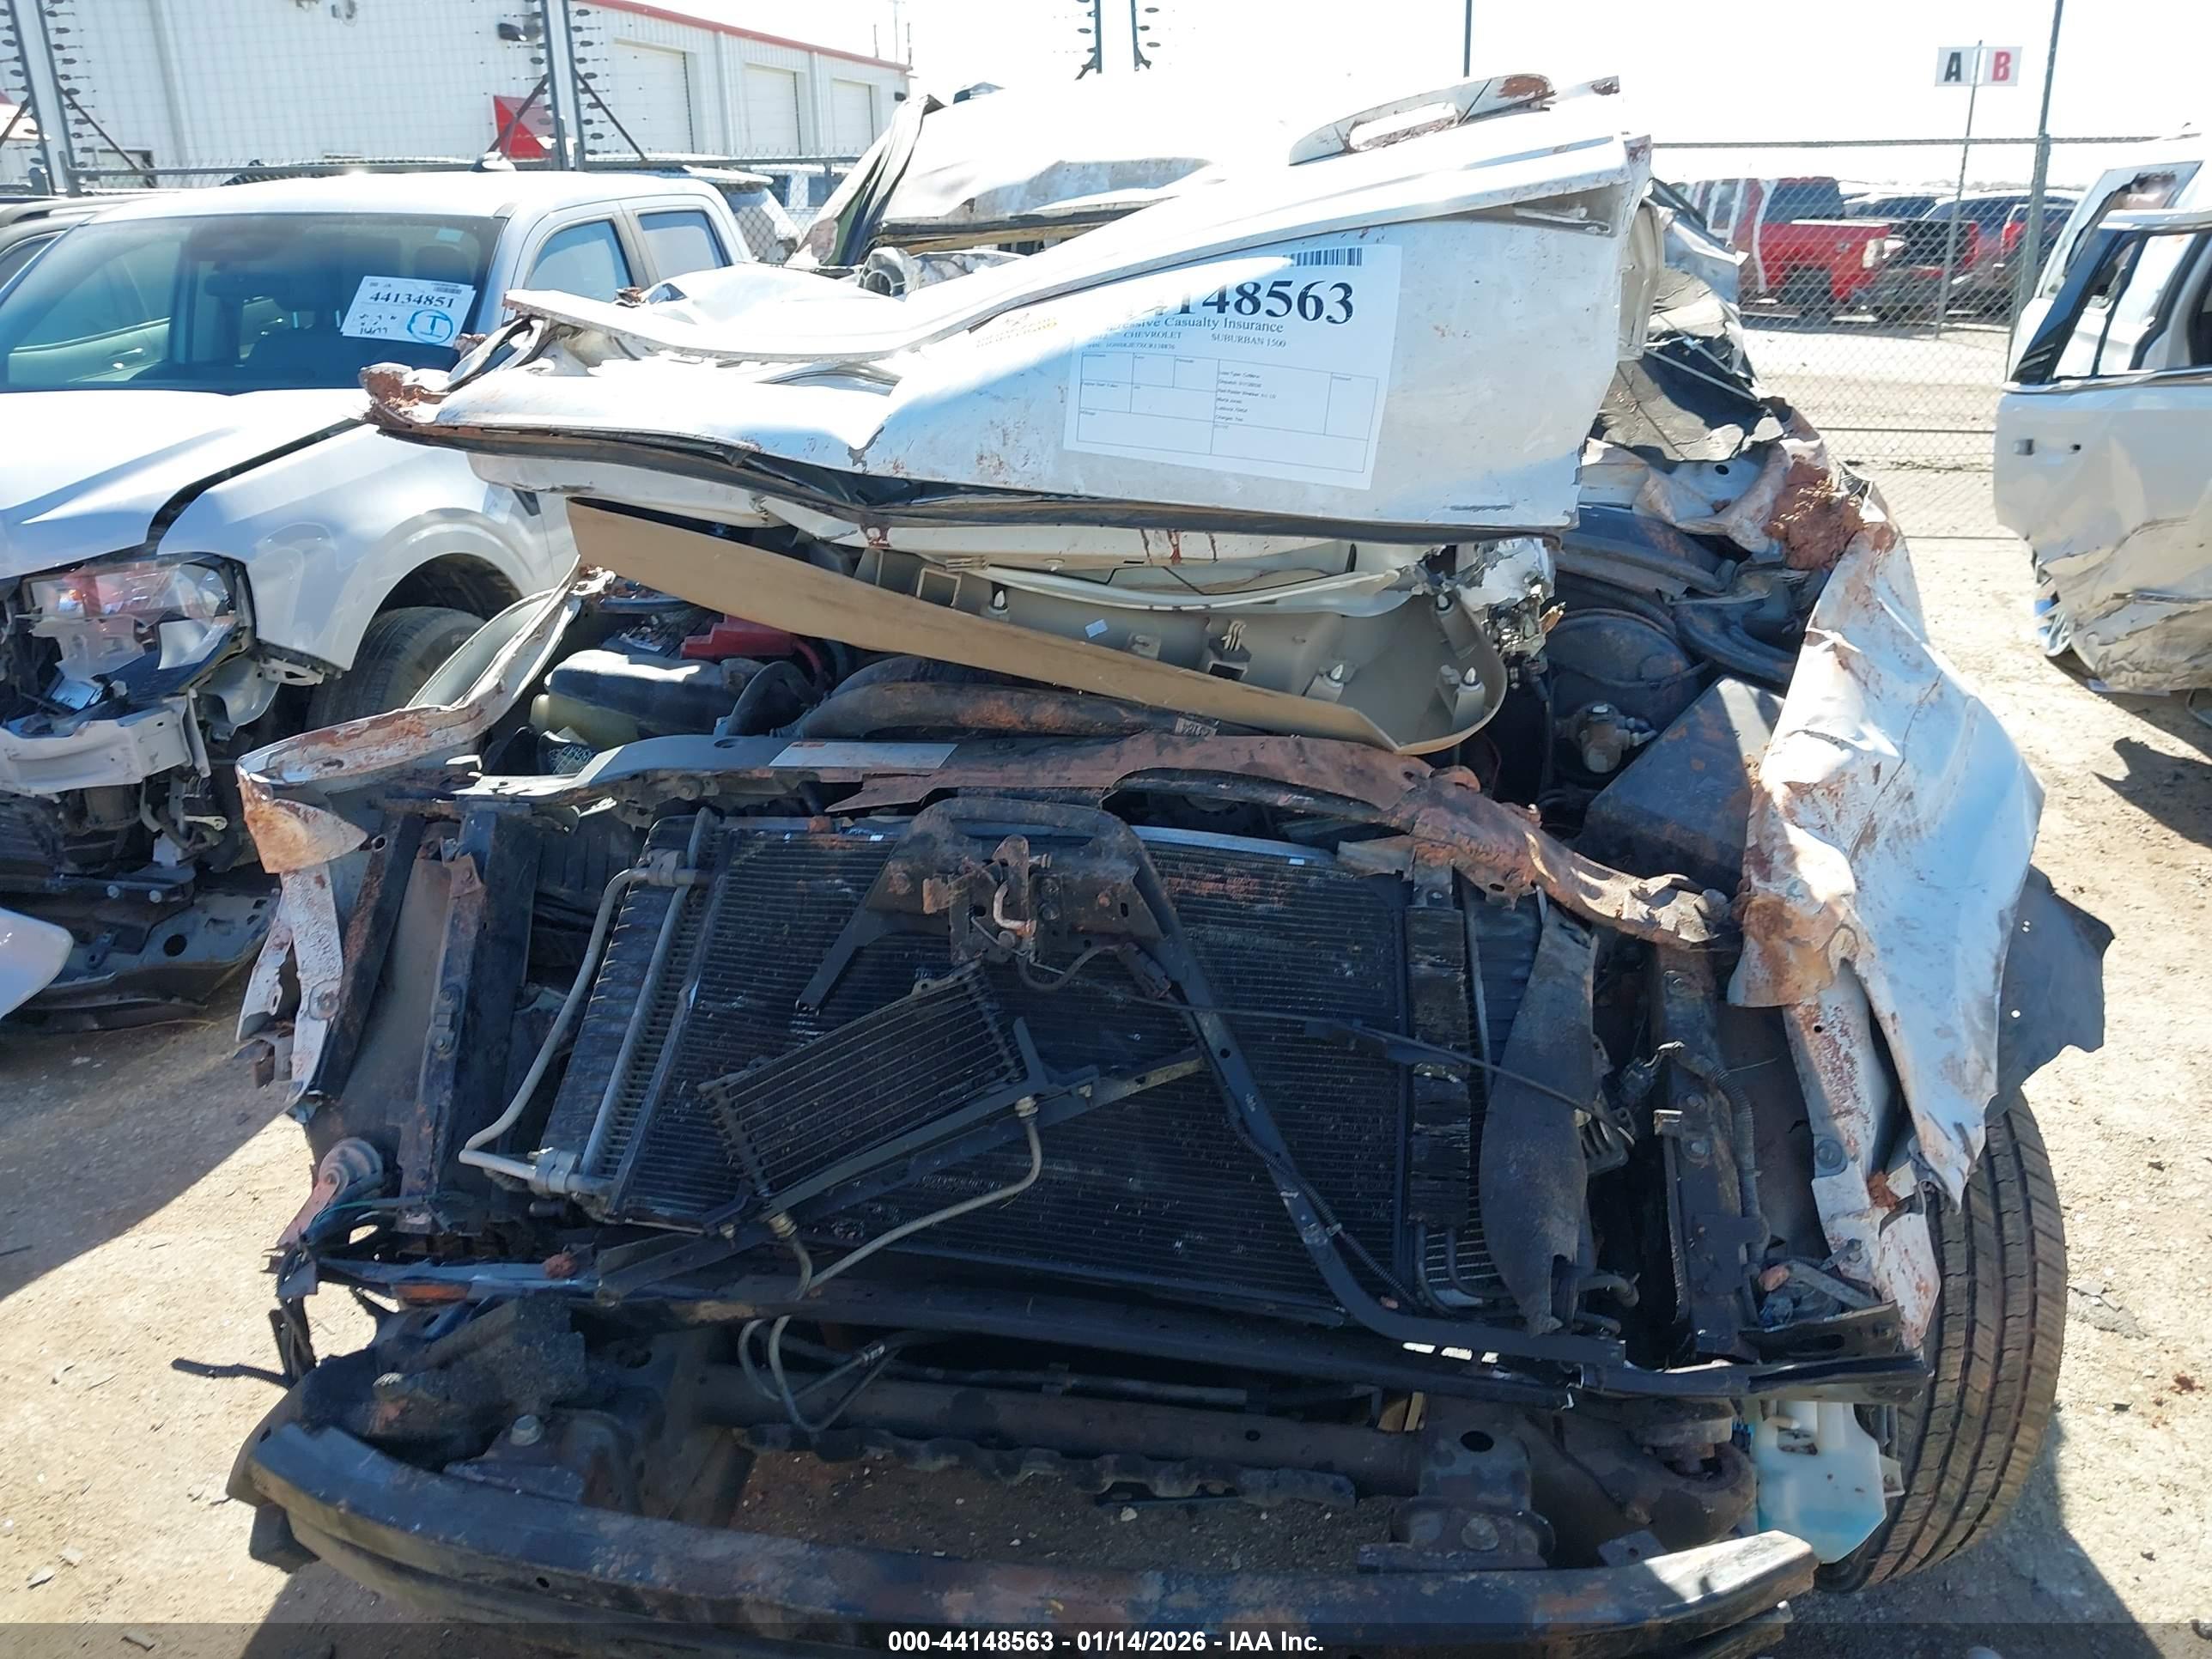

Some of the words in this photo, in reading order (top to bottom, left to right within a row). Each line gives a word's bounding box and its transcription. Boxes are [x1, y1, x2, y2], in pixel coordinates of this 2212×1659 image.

[1943, 52, 1962, 82] A
[1992, 51, 2011, 82] B
[369, 291, 455, 309] 44134851
[1127, 280, 1354, 325] 148563
[1164, 315, 1220, 332] Casualty
[1224, 316, 1285, 334] Insurance
[1123, 331, 1182, 341] CHEVROLET
[1211, 332, 1265, 346] SUBURBAN
